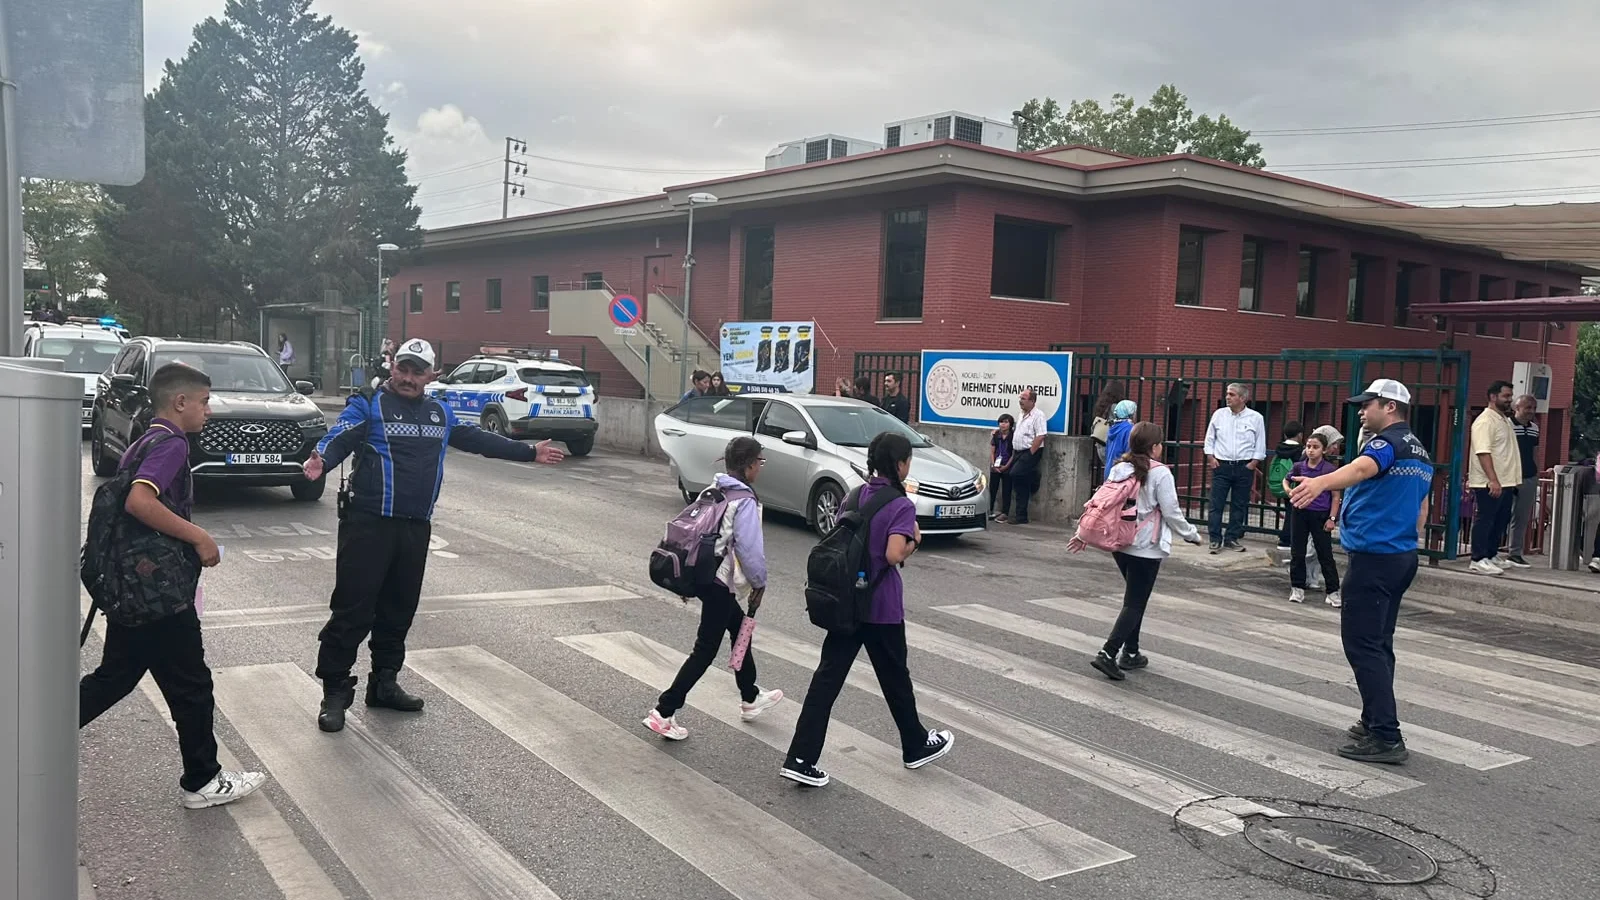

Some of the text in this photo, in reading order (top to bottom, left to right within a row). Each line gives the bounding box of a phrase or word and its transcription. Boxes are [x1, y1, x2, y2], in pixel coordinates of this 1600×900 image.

[723, 350, 734, 361] YENİ
[961, 381, 997, 394] MEHMET
[997, 380, 1025, 395] SİNAN
[960, 396, 1010, 409] ORTAOKULU
[231, 454, 281, 463] 41 BEV 584
[939, 505, 975, 515] 41 ALE 720
